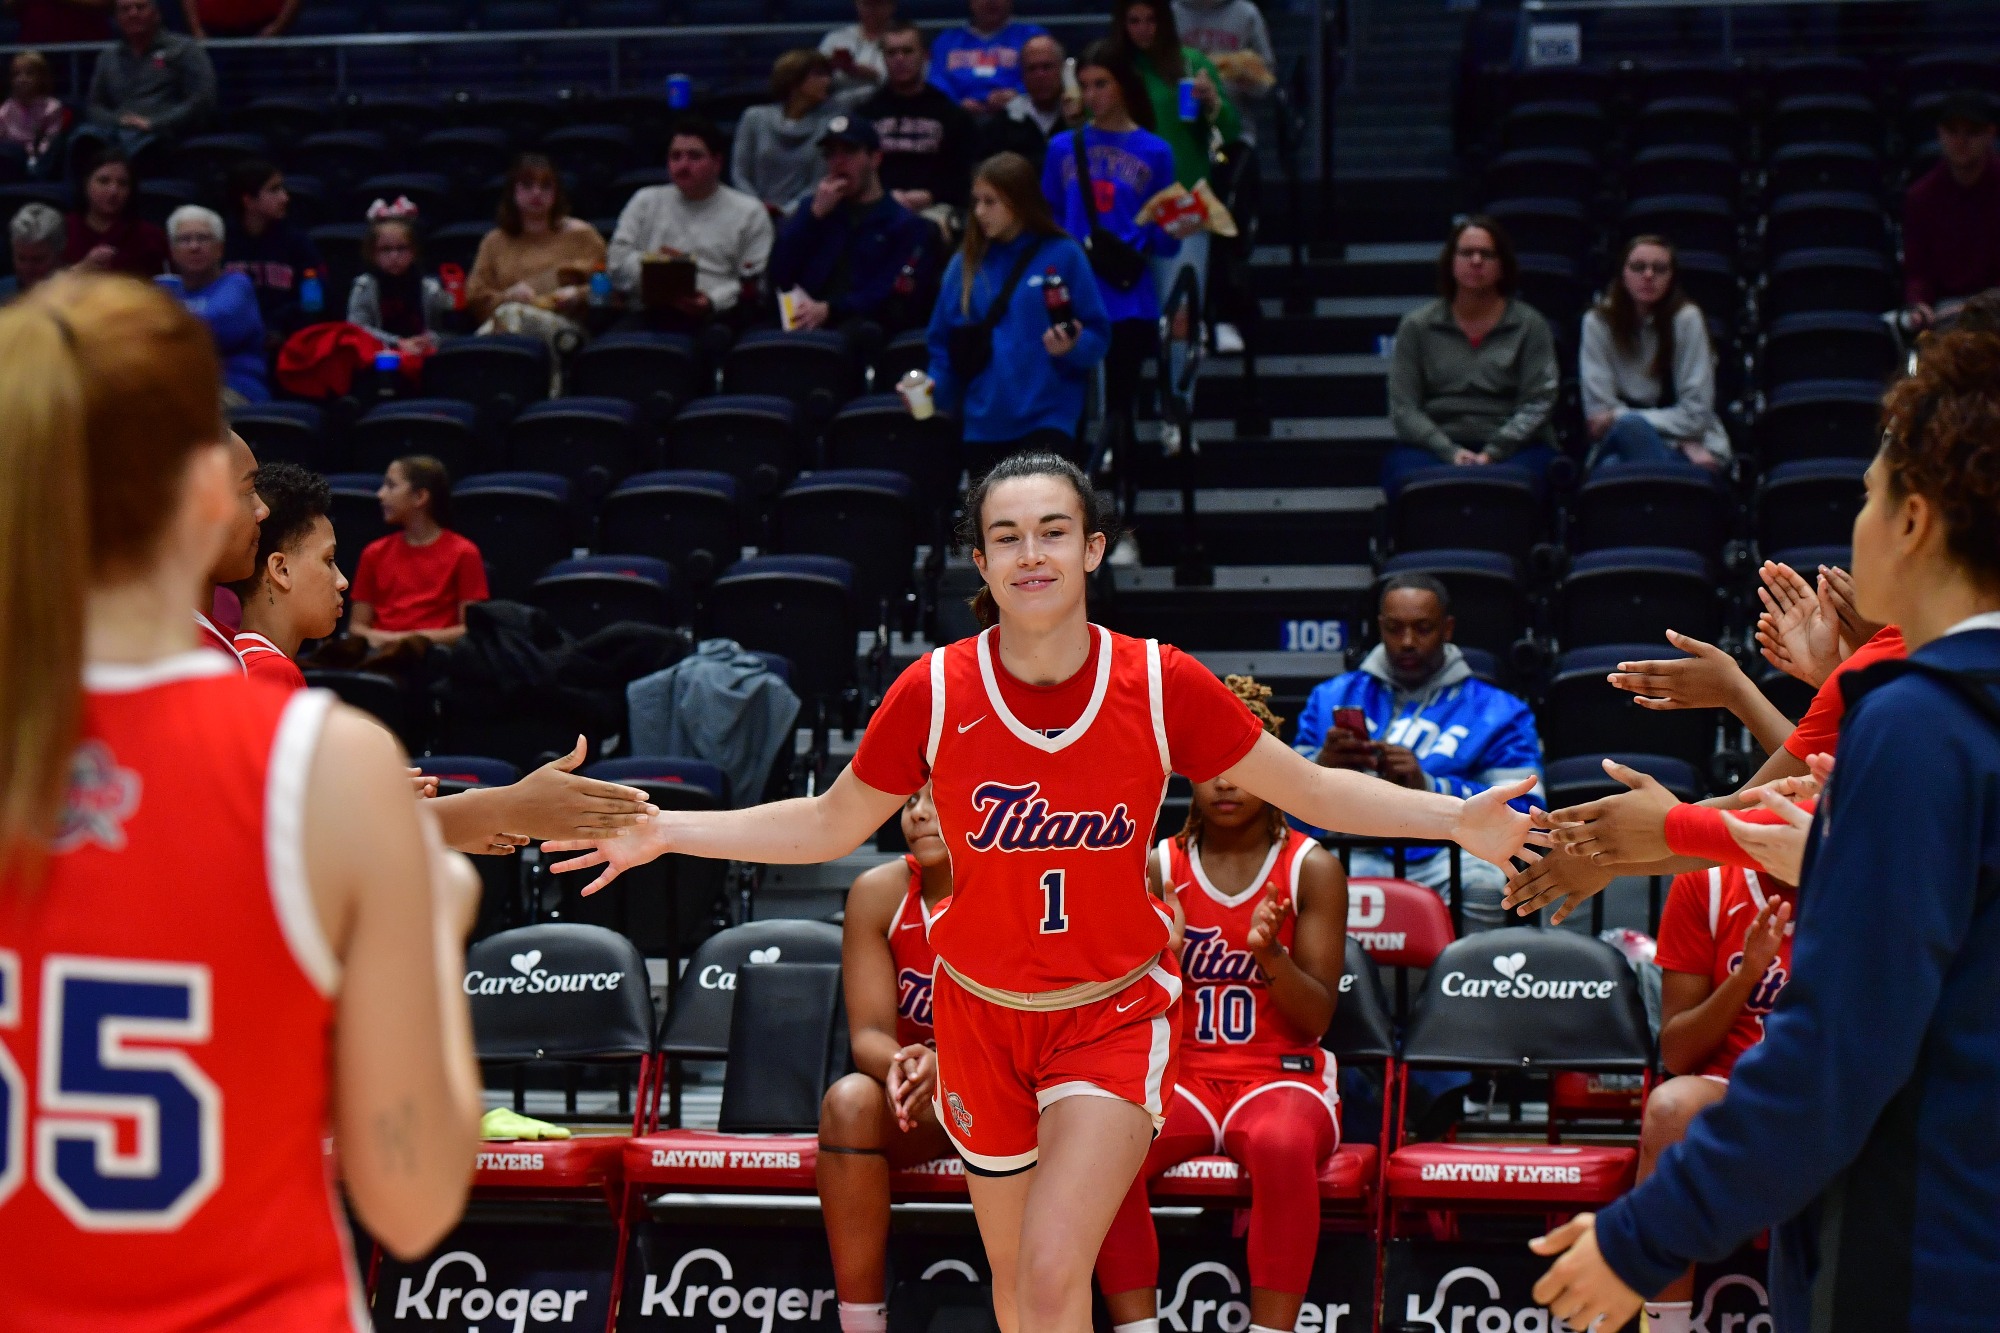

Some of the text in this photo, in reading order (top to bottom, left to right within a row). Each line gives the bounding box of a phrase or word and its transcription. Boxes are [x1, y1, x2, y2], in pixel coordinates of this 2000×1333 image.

[1286, 620, 1342, 650] 106
[966, 781, 1136, 853] Titans
[1039, 869, 1069, 935] 1
[1347, 885, 1386, 928] D
[463, 968, 621, 996] CareSource
[1441, 971, 1614, 1000] CareSource
[1195, 985, 1257, 1045] 10
[476, 1153, 545, 1171] FLYERS
[652, 1150, 800, 1169] DAYTON FLYERS
[1421, 1163, 1582, 1184] DAYTON FLYERS
[394, 1250, 588, 1333] Kroger
[640, 1247, 836, 1333] Kroger
[1156, 1261, 1351, 1333] Kroer
